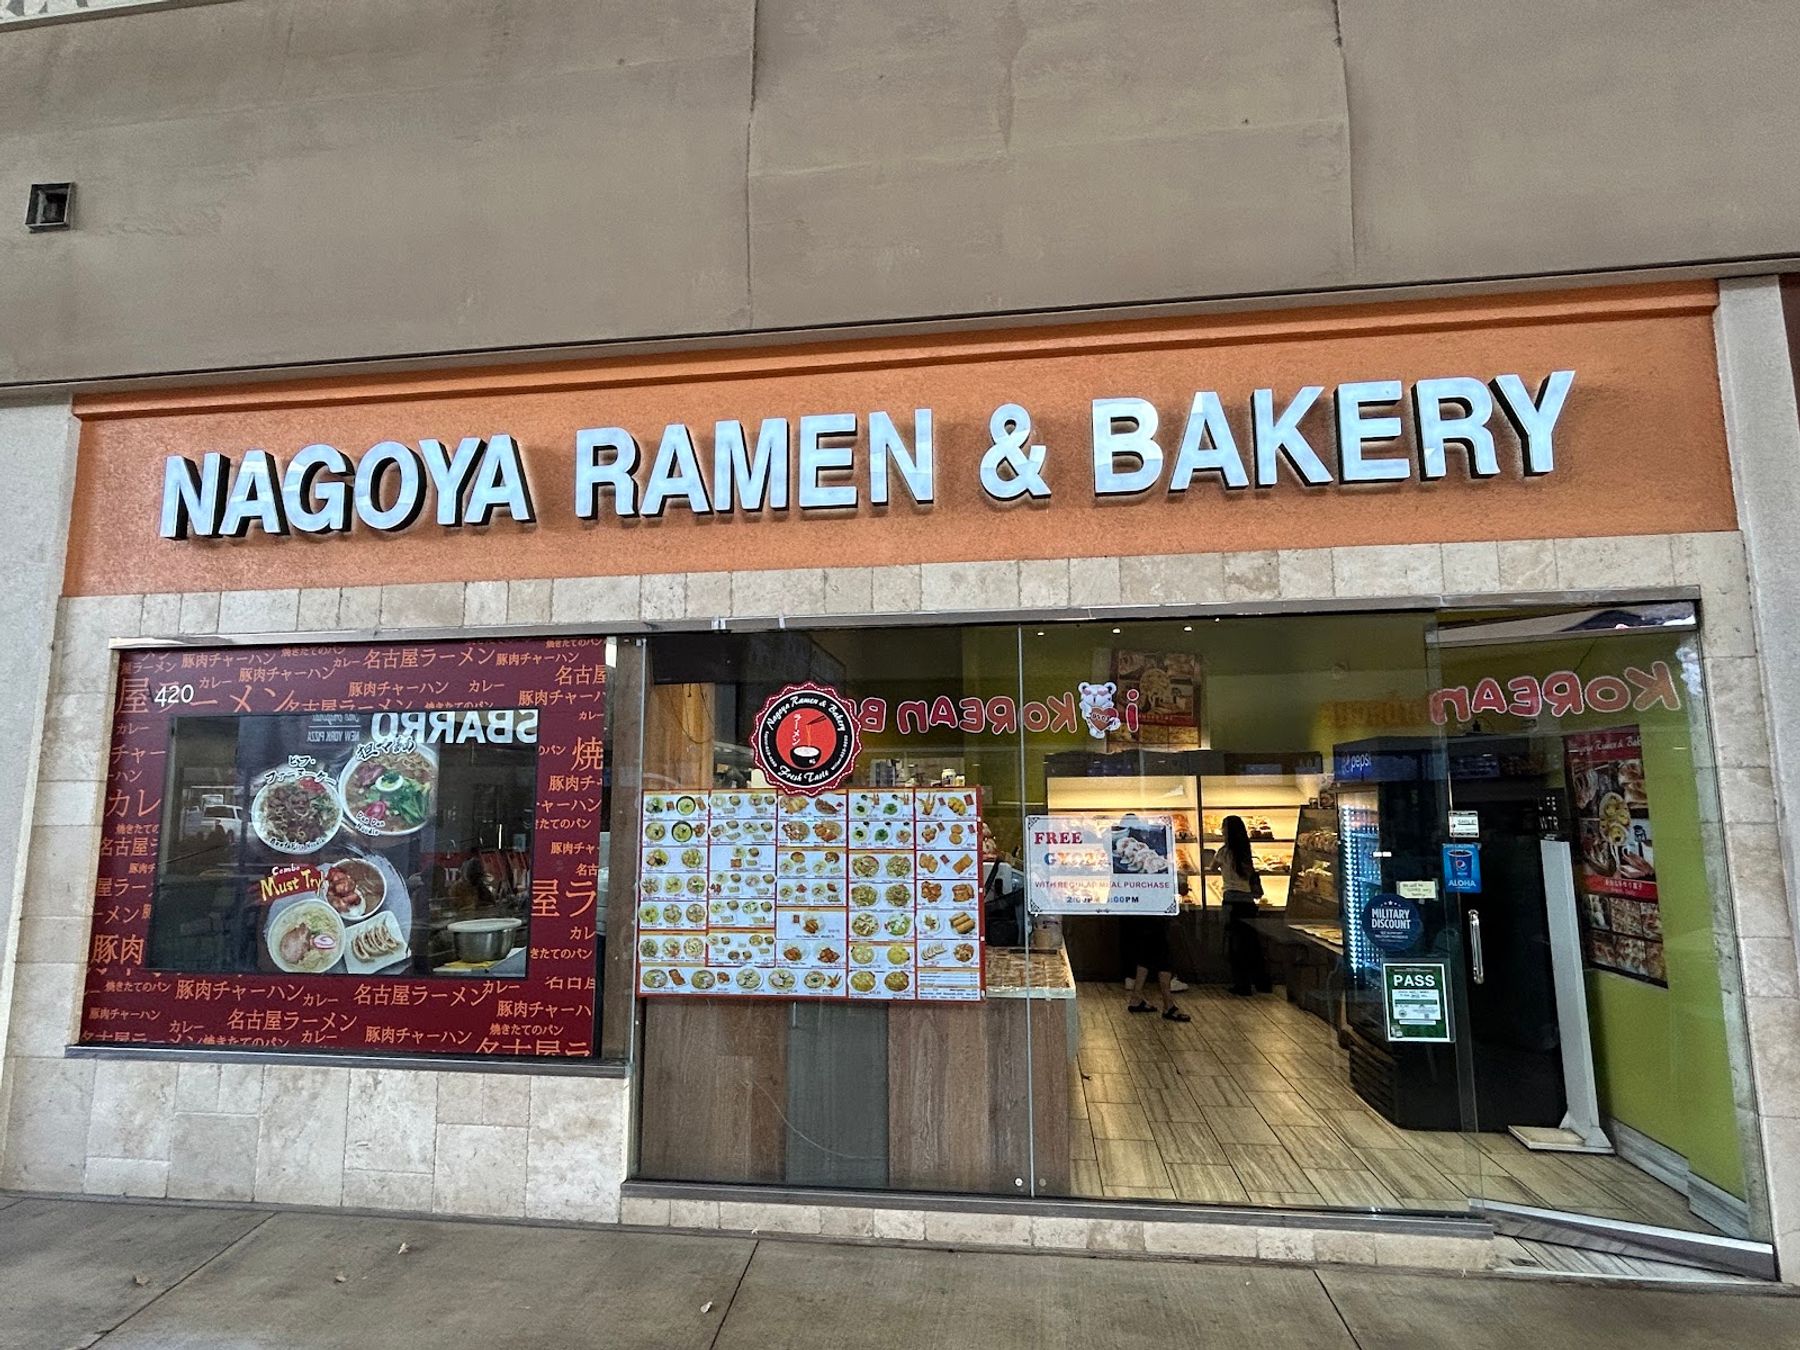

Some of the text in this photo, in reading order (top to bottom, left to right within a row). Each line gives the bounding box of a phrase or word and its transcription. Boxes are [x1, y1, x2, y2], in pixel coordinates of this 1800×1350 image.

[160, 370, 1576, 538] NAGOYA RAMEN & BAKERY
[181, 652, 276, 669] 豚肉チャーハン
[333, 656, 361, 668] カレー
[363, 647, 496, 670] 名古屋ラーメン
[495, 652, 580, 666] 豚肉チャーハン
[238, 666, 336, 682] 豚肉チャーハン
[199, 676, 232, 689] カレー
[348, 680, 449, 698] 豚肉チャーハン
[468, 680, 505, 692] カレー
[154, 683, 195, 707] 420
[578, 711, 604, 721] カレー
[116, 723, 150, 735] カレー
[536, 798, 602, 813] ャーハン
[1034, 831, 1083, 845] FREE
[550, 841, 600, 855] 豚肉チャ
[96, 877, 153, 897] 屋ラー
[260, 875, 300, 902] Must
[1124, 881, 1170, 889] PURCHASE
[1448, 879, 1477, 887] ALOHA
[1371, 908, 1410, 919] MILITARY
[1371, 918, 1411, 929] DISCOUNT
[90, 934, 145, 966] 豚肉
[530, 947, 593, 960] きたてのパン
[481, 979, 521, 994] カレー
[1393, 974, 1436, 987] PASS
[175, 979, 305, 1001] 豚肉チャーハン
[353, 983, 490, 1007] 名古屋ラーメン
[302, 993, 339, 1007] カレー
[496, 999, 592, 1019] 豚肉チャーハ
[169, 1019, 205, 1034] カレー
[227, 1008, 358, 1032] 名古屋ラーメン
[300, 1029, 338, 1044] カレー
[364, 1025, 473, 1045] 豚肉チャーハン
